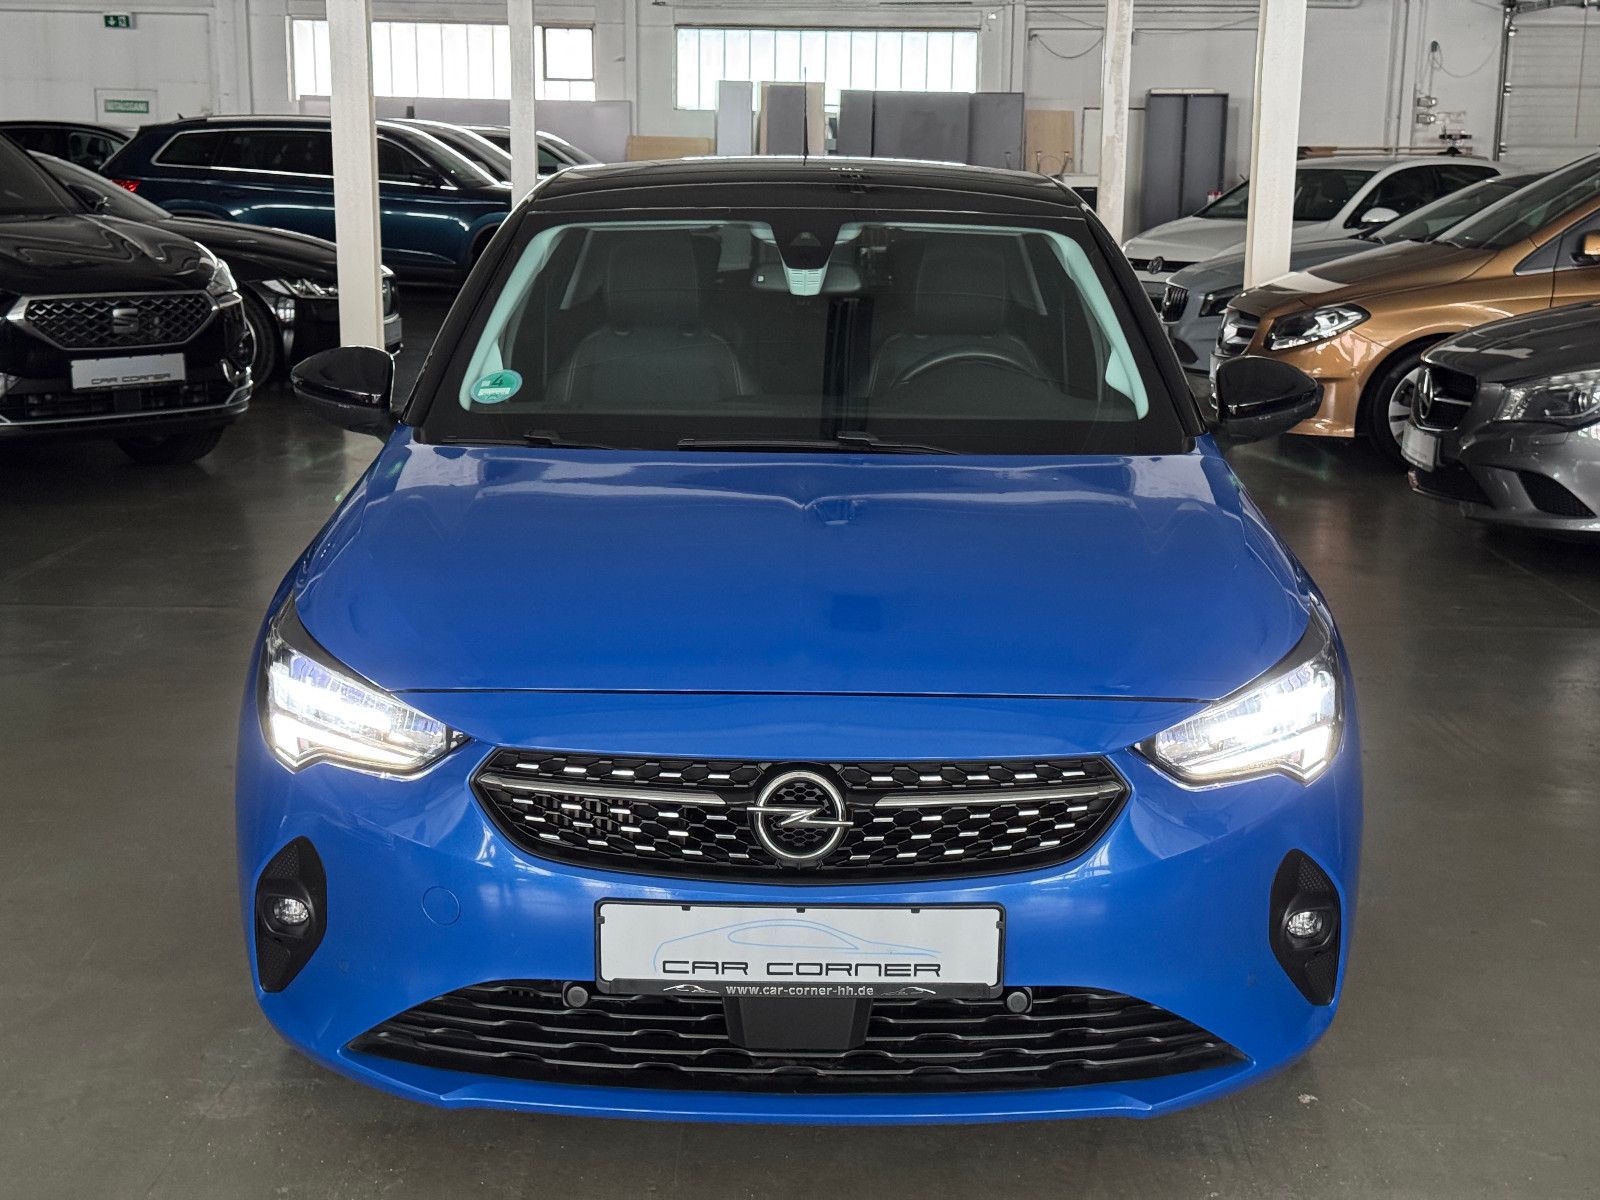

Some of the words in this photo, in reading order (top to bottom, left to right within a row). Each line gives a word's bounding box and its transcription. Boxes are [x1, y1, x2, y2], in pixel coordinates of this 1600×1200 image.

[491, 374, 504, 386] 4
[662, 960, 749, 976] CAR
[766, 962, 942, 978] CORNER
[725, 984, 874, 997] www.car-corner-hh.de
